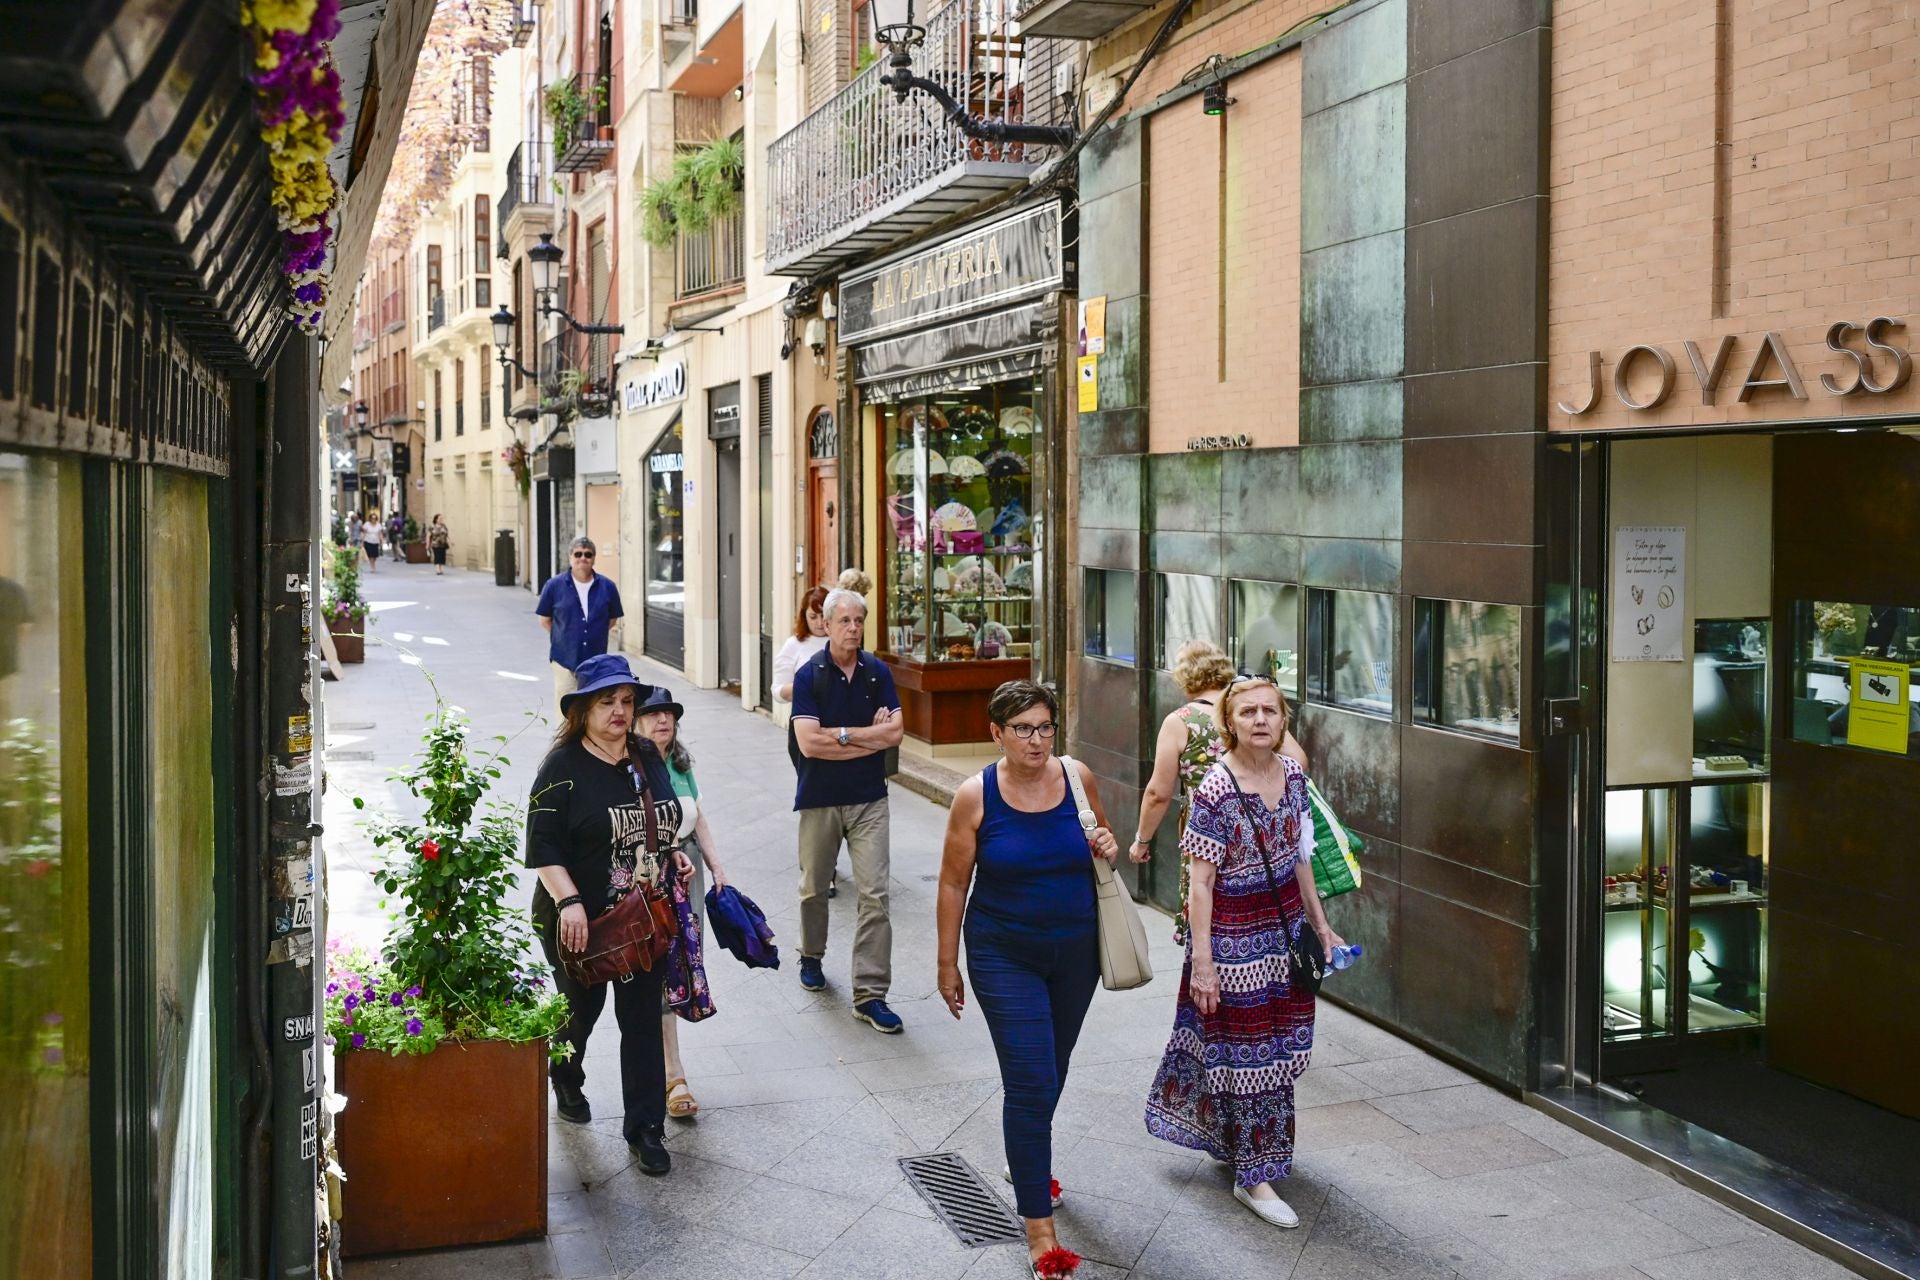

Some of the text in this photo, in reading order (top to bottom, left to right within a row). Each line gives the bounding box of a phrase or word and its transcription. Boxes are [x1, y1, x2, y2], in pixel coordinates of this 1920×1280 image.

[871, 235, 1002, 313] LA PLATERIA
[1219, 432, 1252, 449] CANO
[608, 799, 679, 844] NASHLLE
[621, 831, 647, 848] TENNES
[657, 831, 671, 843] USA
[303, 1104, 316, 1123] DO
